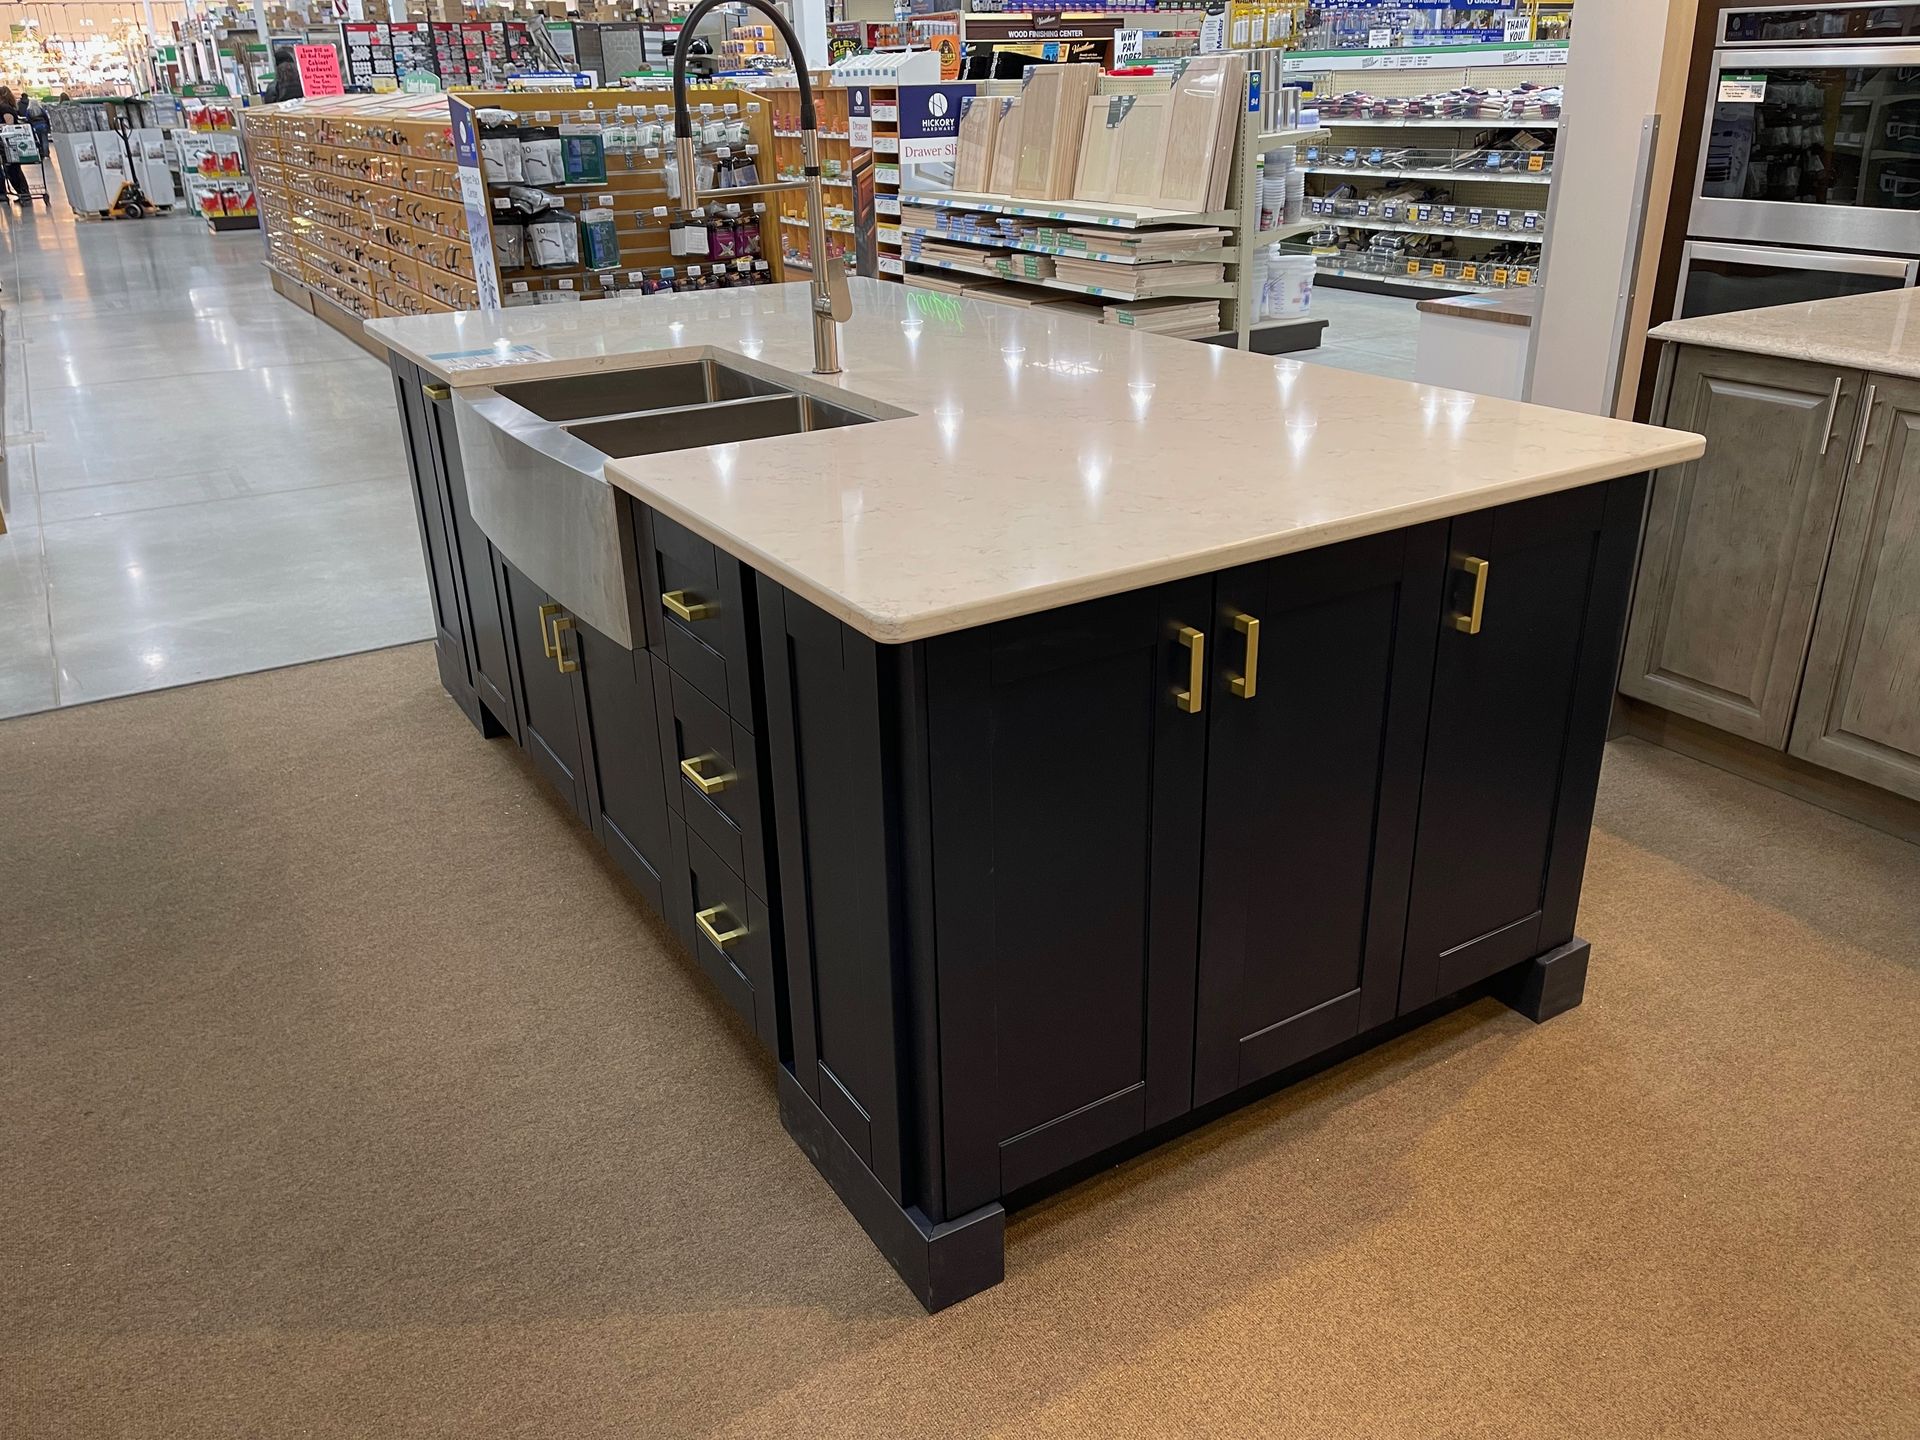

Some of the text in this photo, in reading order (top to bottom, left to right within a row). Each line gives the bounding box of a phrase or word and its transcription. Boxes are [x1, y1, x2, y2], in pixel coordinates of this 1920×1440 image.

[1506, 19, 1528, 30] THANK
[1120, 30, 1138, 41] WHY
[1509, 31, 1525, 42] YOU!
[832, 40, 856, 51] FLEX
[1122, 42, 1136, 52] PAY
[922, 118, 955, 127] HICKORY
[905, 144, 957, 157] Drawer Sli
